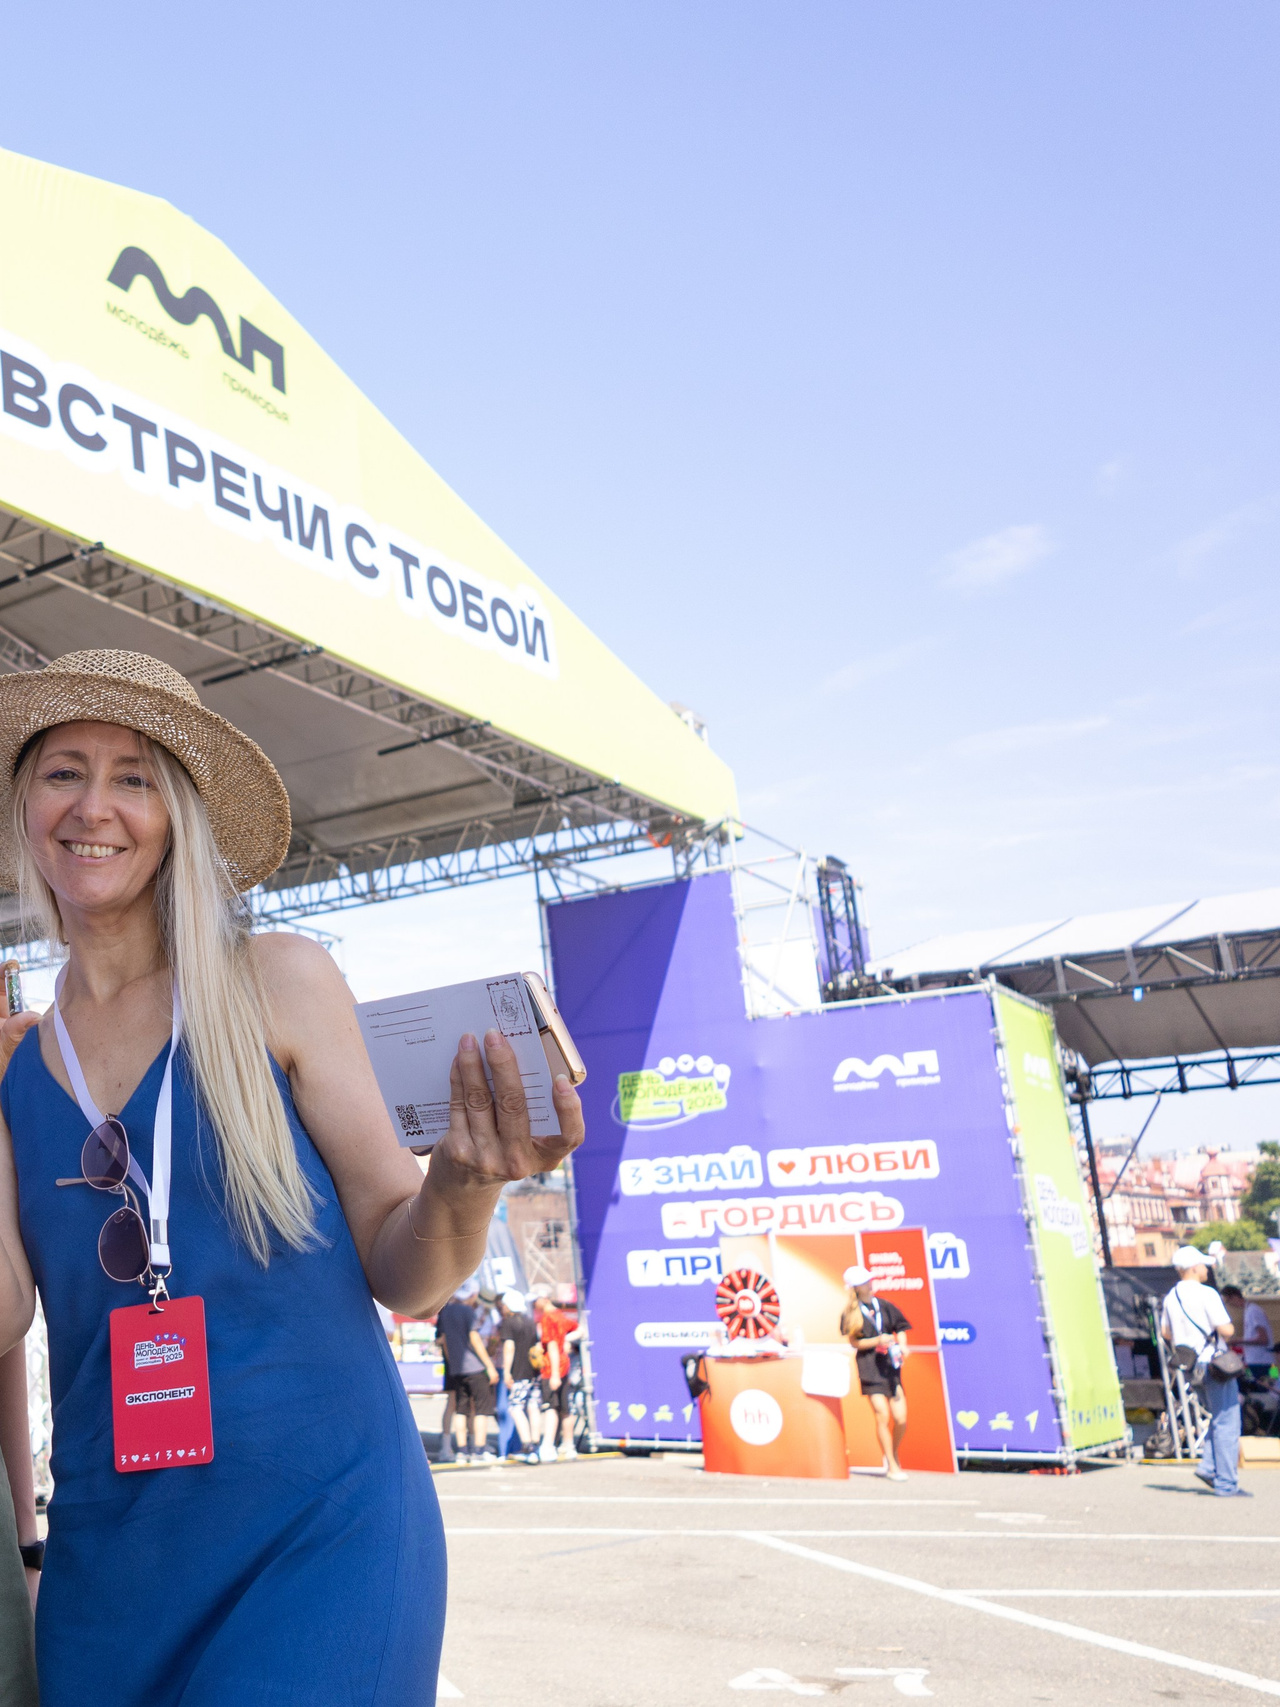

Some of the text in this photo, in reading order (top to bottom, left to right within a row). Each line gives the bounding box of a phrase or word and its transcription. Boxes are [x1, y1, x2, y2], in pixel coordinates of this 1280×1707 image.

[222, 372, 289, 425] приморья
[0, 348, 335, 561] ВСТРЕЧИ
[344, 522, 381, 580] С
[388, 542, 551, 663] ТОБОЙ
[654, 1153, 756, 1186] ЗНАЙ
[808, 1148, 932, 1176] ЛЮБИ
[699, 1200, 897, 1230] ГОРДИСЬ
[135, 1342, 155, 1351] ДЕНЬ
[135, 1345, 179, 1357] МОЛОДЁЖИ
[165, 1352, 183, 1362] 2025
[126, 1387, 194, 1404] ЭКСПОНЕНТ
